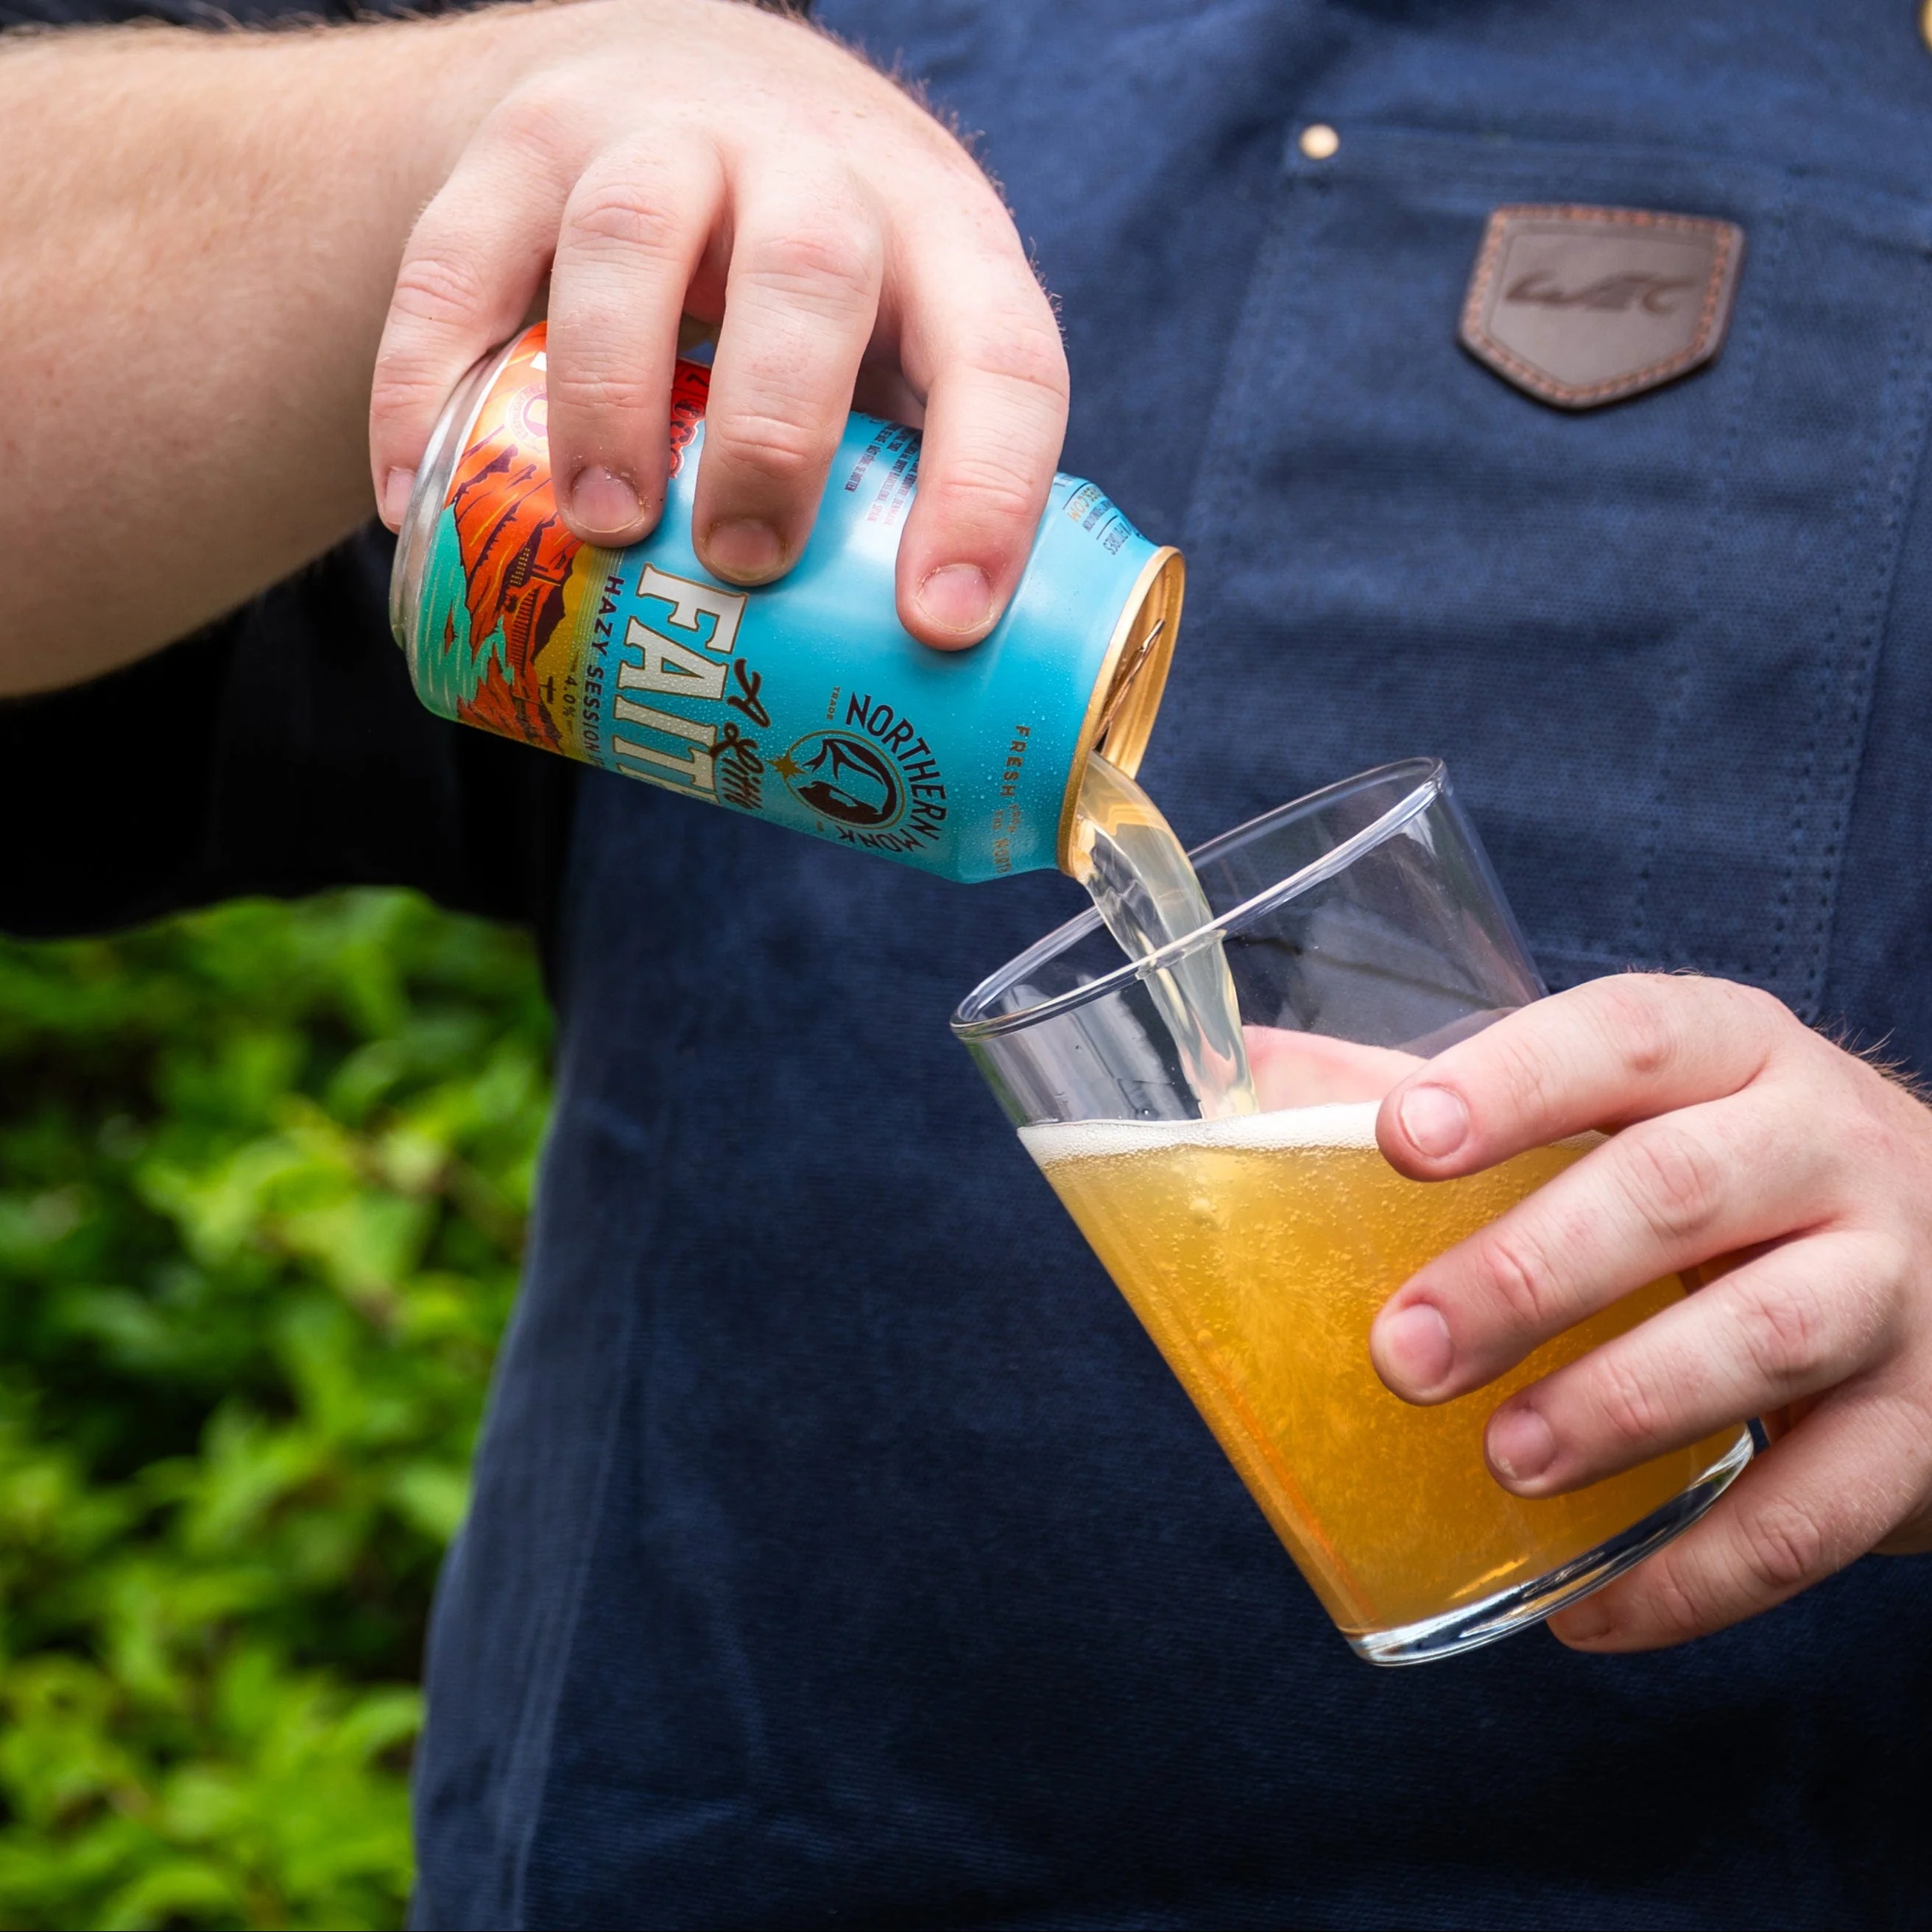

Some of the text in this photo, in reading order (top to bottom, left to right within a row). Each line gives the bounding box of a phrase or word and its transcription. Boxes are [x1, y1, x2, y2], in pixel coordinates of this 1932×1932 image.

[591, 575, 624, 656] HAZY
[563, 674, 577, 717] 4.0%
[583, 664, 604, 753] SESSION
[726, 657, 772, 728] A
[834, 691, 948, 853] NORTHERN MONK
[999, 724, 1031, 797] FRESH
